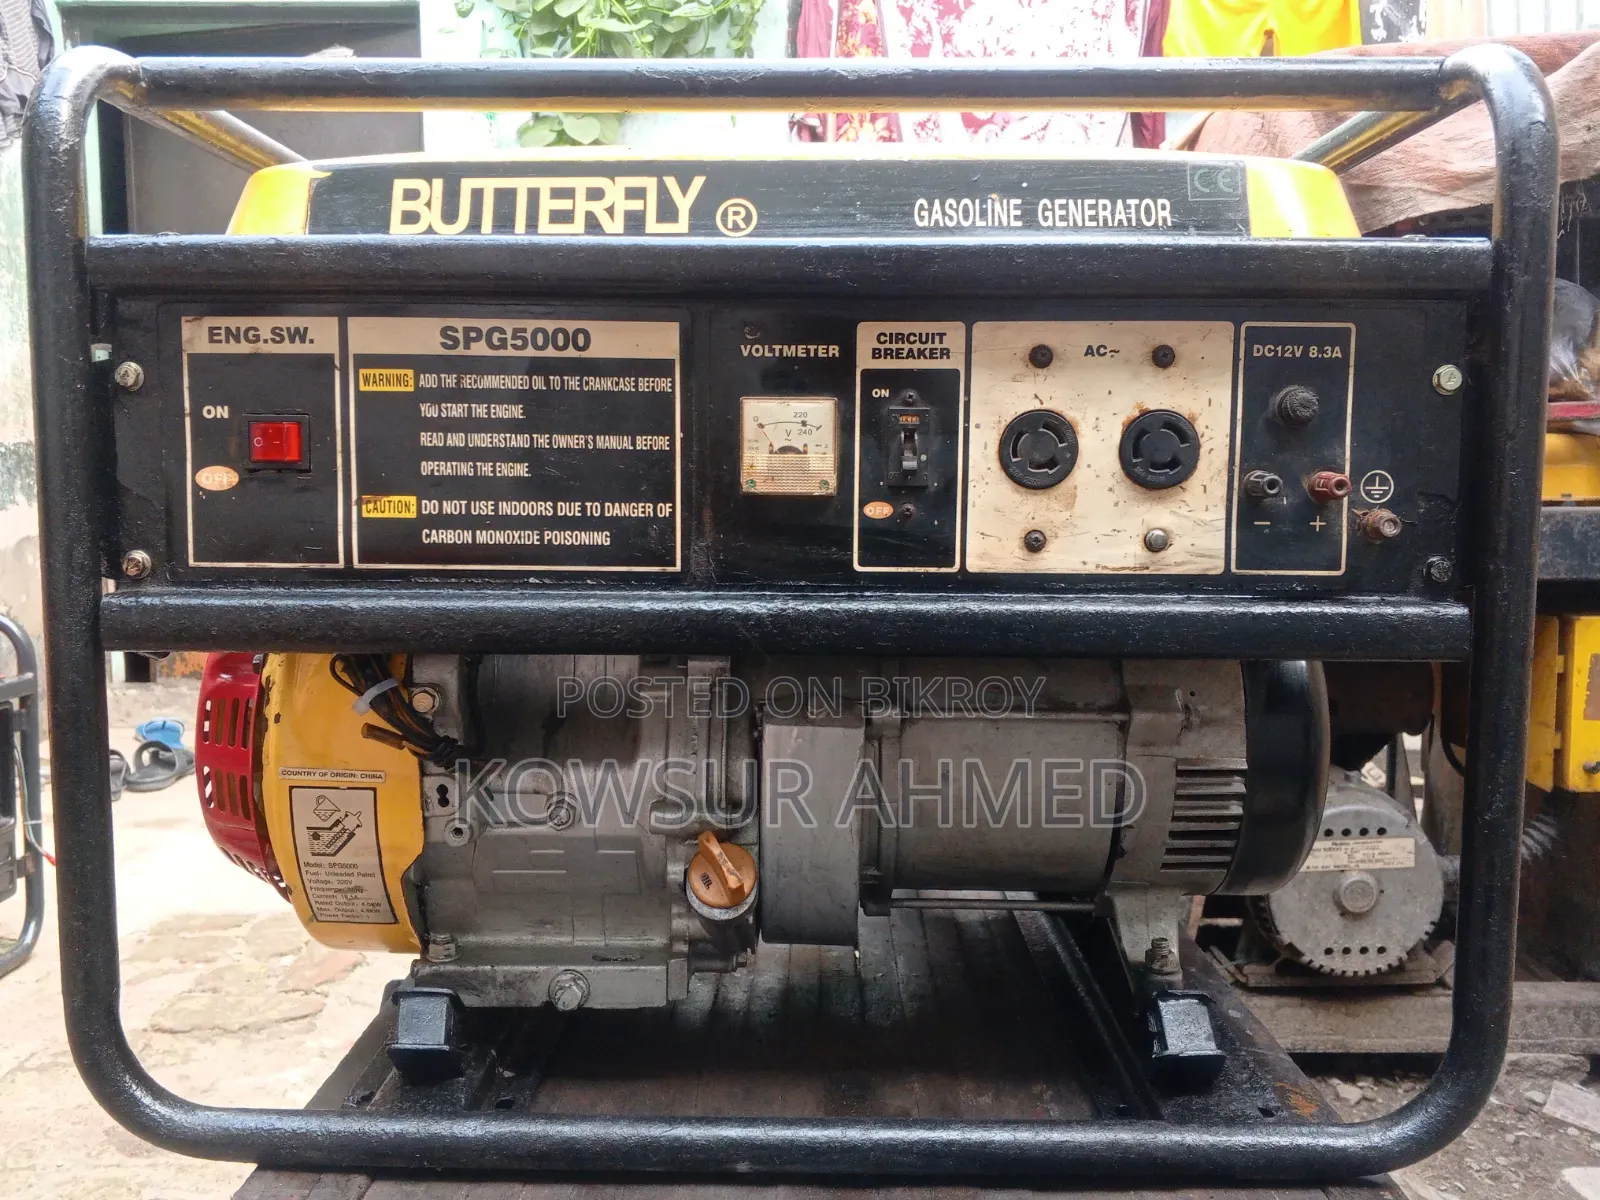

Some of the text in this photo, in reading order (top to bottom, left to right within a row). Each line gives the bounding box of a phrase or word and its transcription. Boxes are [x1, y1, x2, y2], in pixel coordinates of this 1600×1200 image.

[389, 175, 707, 235] BUTTERFLY
[913, 198, 1172, 227] GASOLINE GENERATOR
[208, 326, 314, 344] ENG.SW.
[439, 325, 592, 352] SPG5000
[876, 332, 947, 345] CIRCUIT
[740, 344, 840, 358] VOLTMETER
[871, 347, 951, 360] BREAKER
[1253, 344, 1342, 358] DC12V 8.3A
[362, 373, 673, 392] WARNING: ADD THE RECOMMENDED OIL TO THE CRANKCASE BEFORE
[872, 388, 890, 398] ON
[202, 405, 229, 419] ON
[419, 402, 526, 419] YOU START THE ENGINE.
[420, 432, 670, 450] READ AND UNDERSTAND THE OWNER'S MANUAL BEFORE
[420, 461, 532, 477] OPERATING THE ENGINE.
[365, 500, 673, 517] CAUTION: DO NOT USE INDOORS DUE TO DANGER OF
[866, 506, 890, 516] OFF
[422, 529, 611, 546] CARBON MONOXIDE POISONING
[281, 769, 317, 777] COUNTRY
